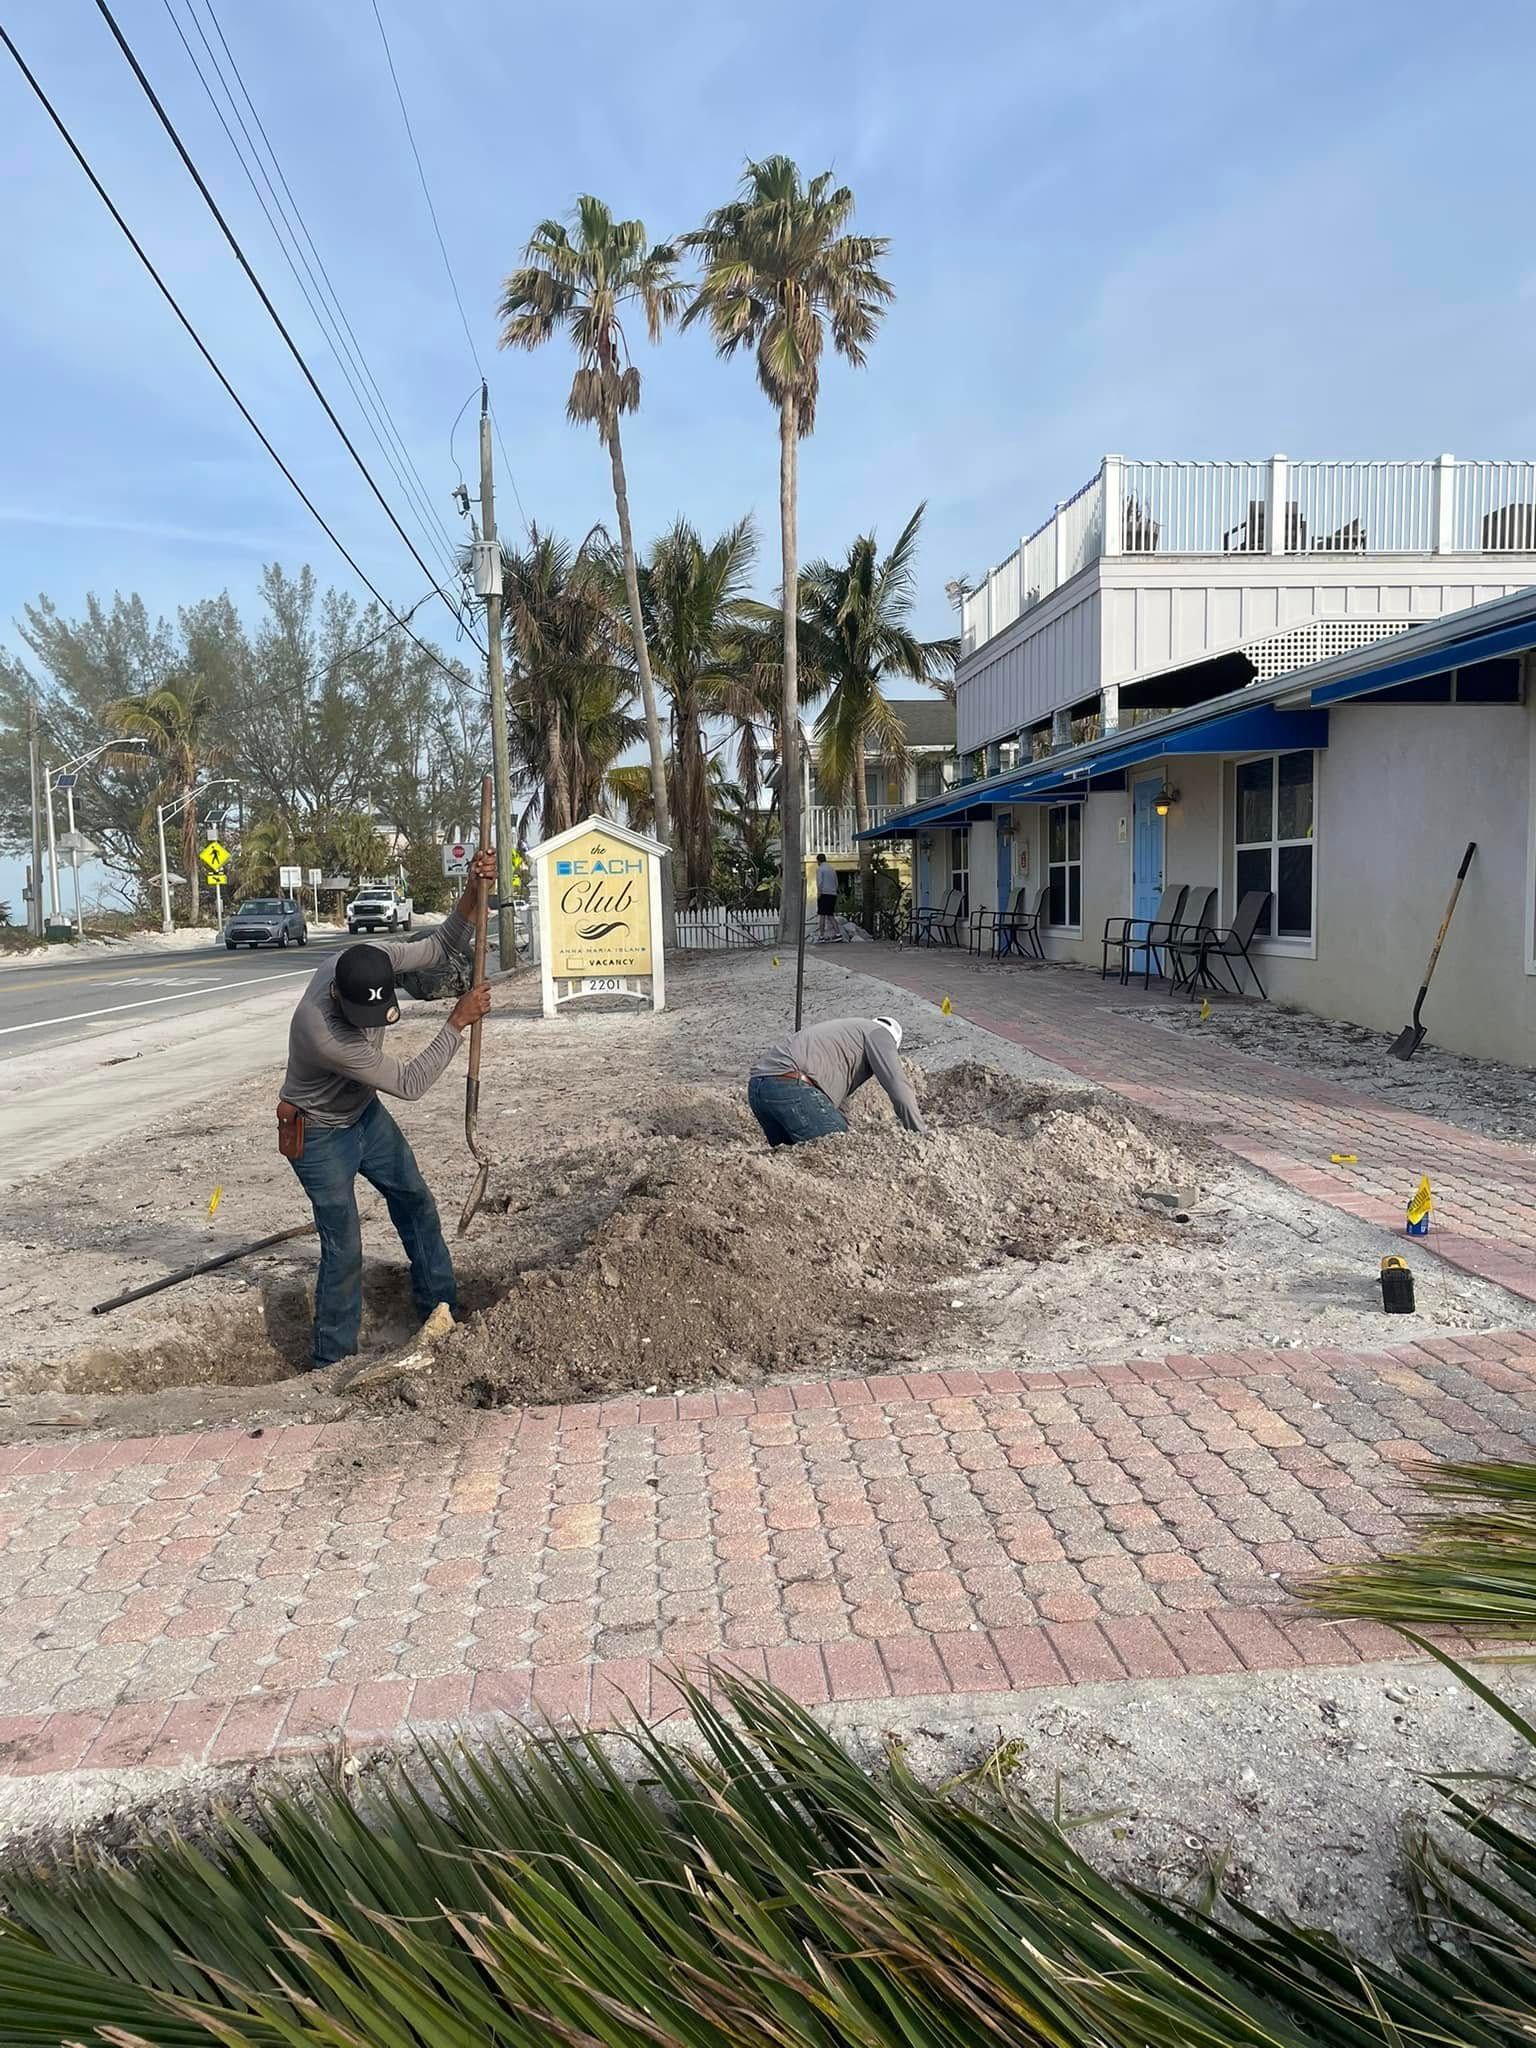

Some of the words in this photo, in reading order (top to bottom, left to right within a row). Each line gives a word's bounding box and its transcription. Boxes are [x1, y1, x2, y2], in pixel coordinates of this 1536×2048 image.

[590, 844, 606, 855] the
[556, 859, 642, 876] BEACH
[561, 880, 638, 915] Club
[589, 958, 634, 966] VACANCY
[590, 979, 620, 991] 2201
